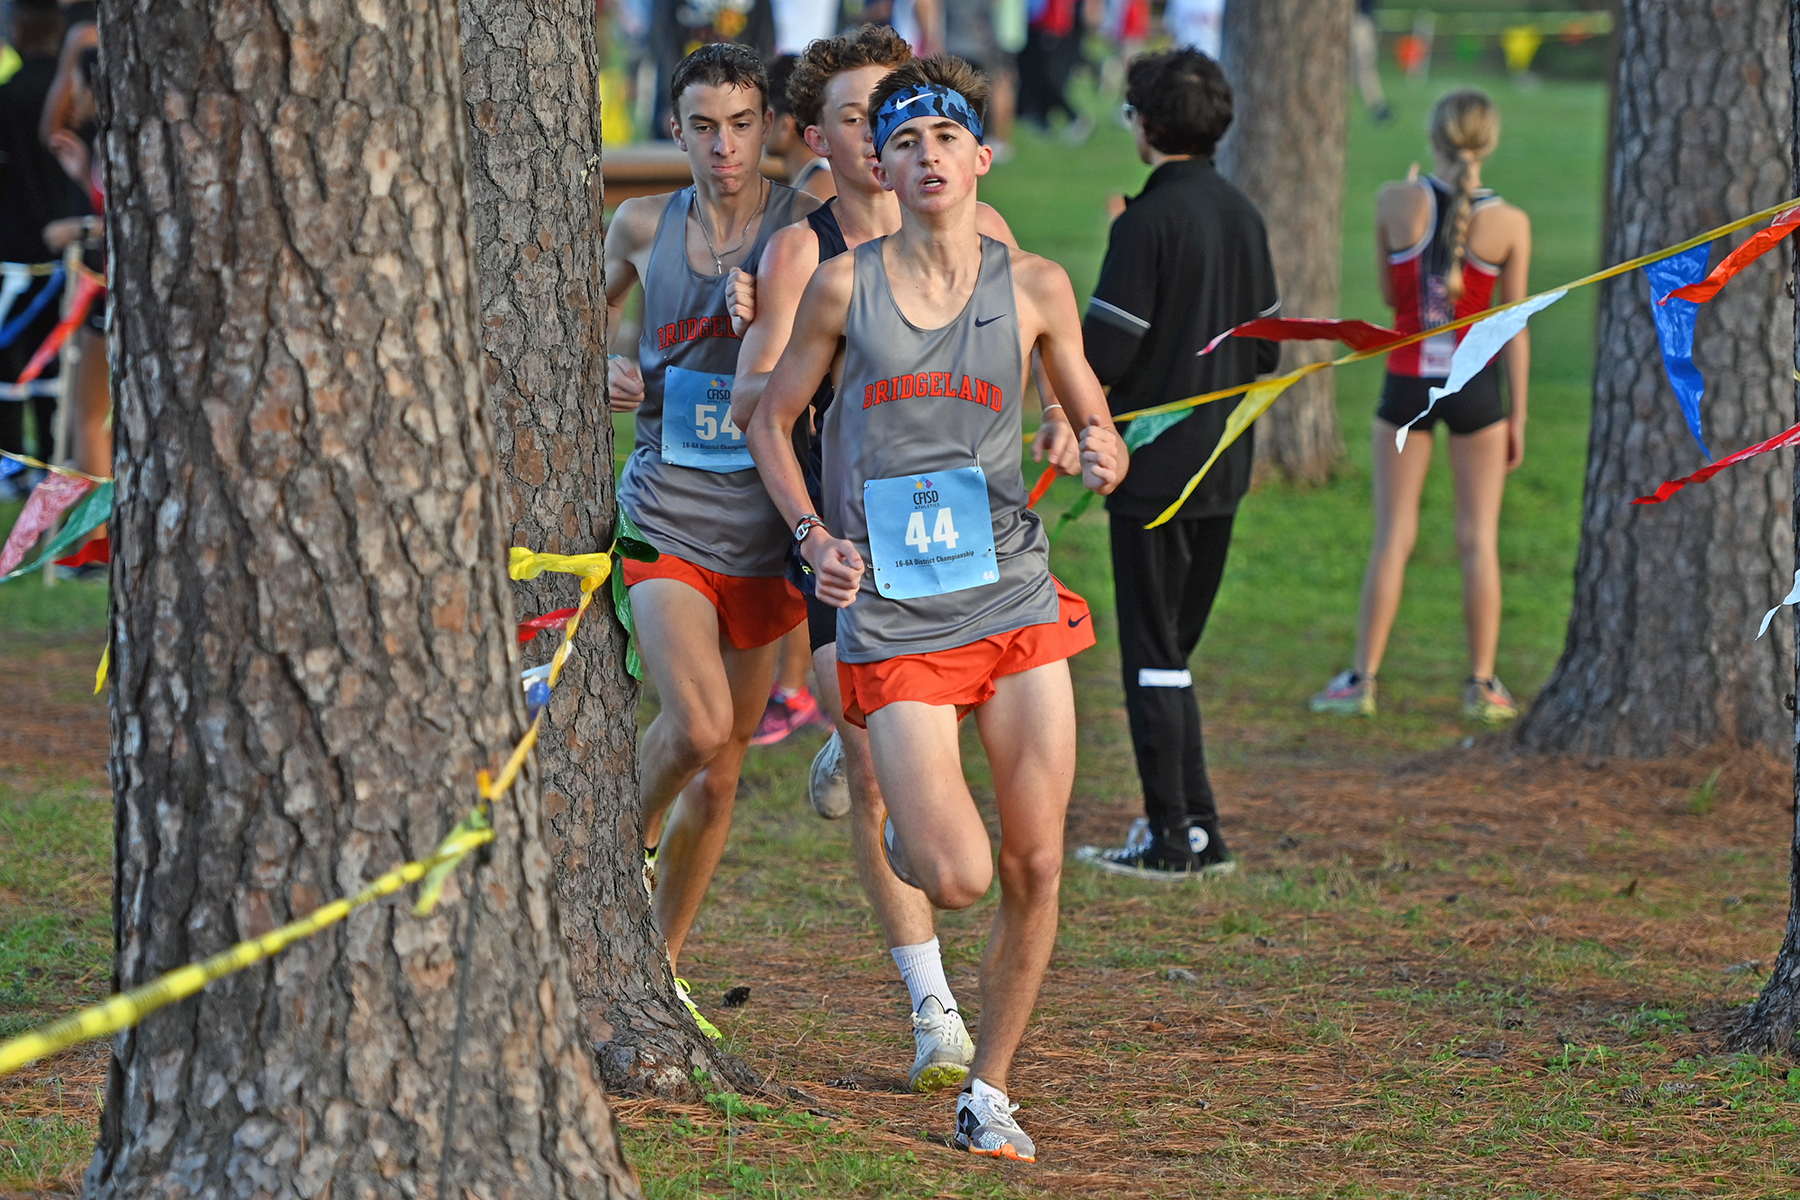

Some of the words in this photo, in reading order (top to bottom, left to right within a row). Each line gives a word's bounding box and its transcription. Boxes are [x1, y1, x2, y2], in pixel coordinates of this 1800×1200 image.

[657, 315, 742, 351] BRIDGEL
[707, 388, 731, 400] CFISD
[862, 371, 1003, 413] BRIDGELAND
[695, 403, 742, 441] 54
[682, 441, 699, 449] 16-6A
[700, 442, 720, 450] District
[720, 443, 748, 451] Champion
[913, 490, 939, 505] CFISD
[904, 506, 960, 554] 44
[895, 559, 914, 568] 16-6A
[914, 557, 935, 566] District
[935, 549, 975, 562] Championship
[983, 570, 995, 581] 44
